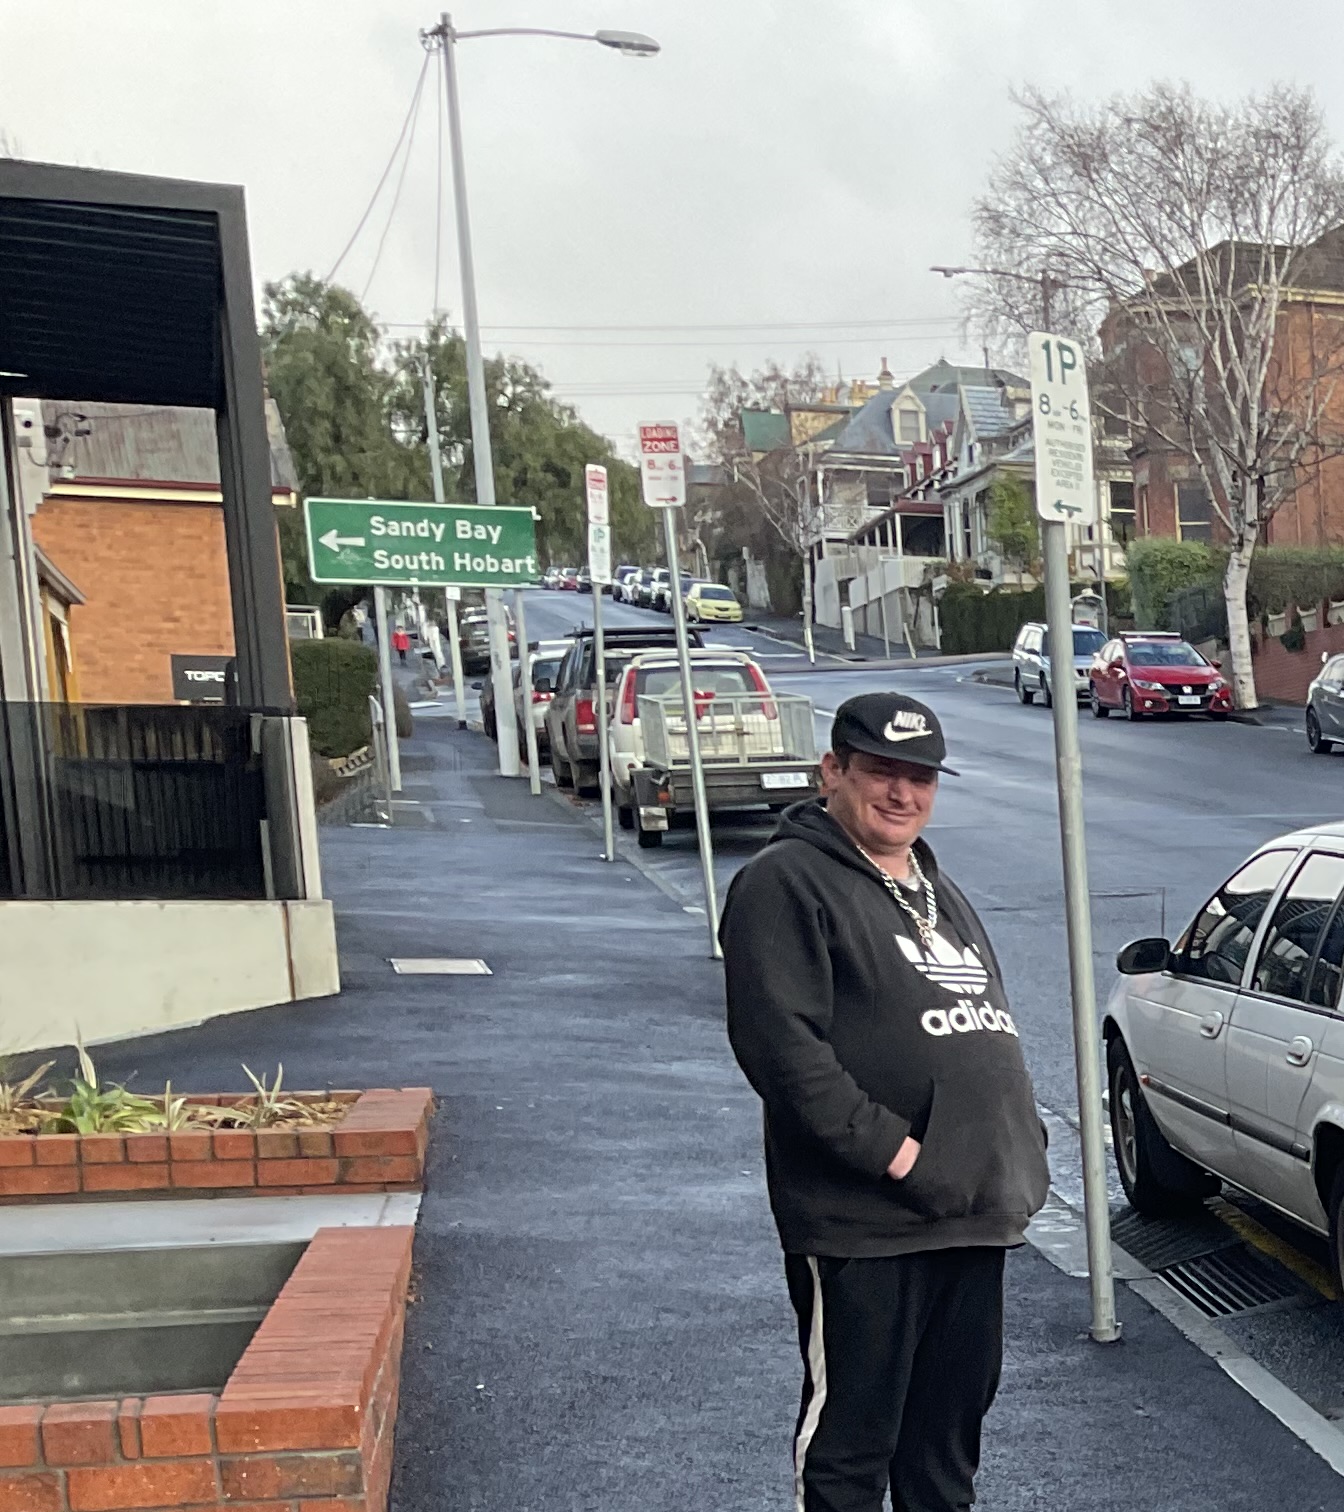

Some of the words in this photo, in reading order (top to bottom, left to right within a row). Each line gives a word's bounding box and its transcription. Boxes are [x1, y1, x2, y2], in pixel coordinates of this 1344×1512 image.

[1042, 340, 1077, 385] 1P
[641, 426, 676, 439] LOADING
[643, 440, 678, 452] ZONE
[370, 516, 445, 542] Sandy
[455, 520, 502, 544] Bay
[374, 550, 445, 570] South
[454, 552, 536, 574] Hobart
